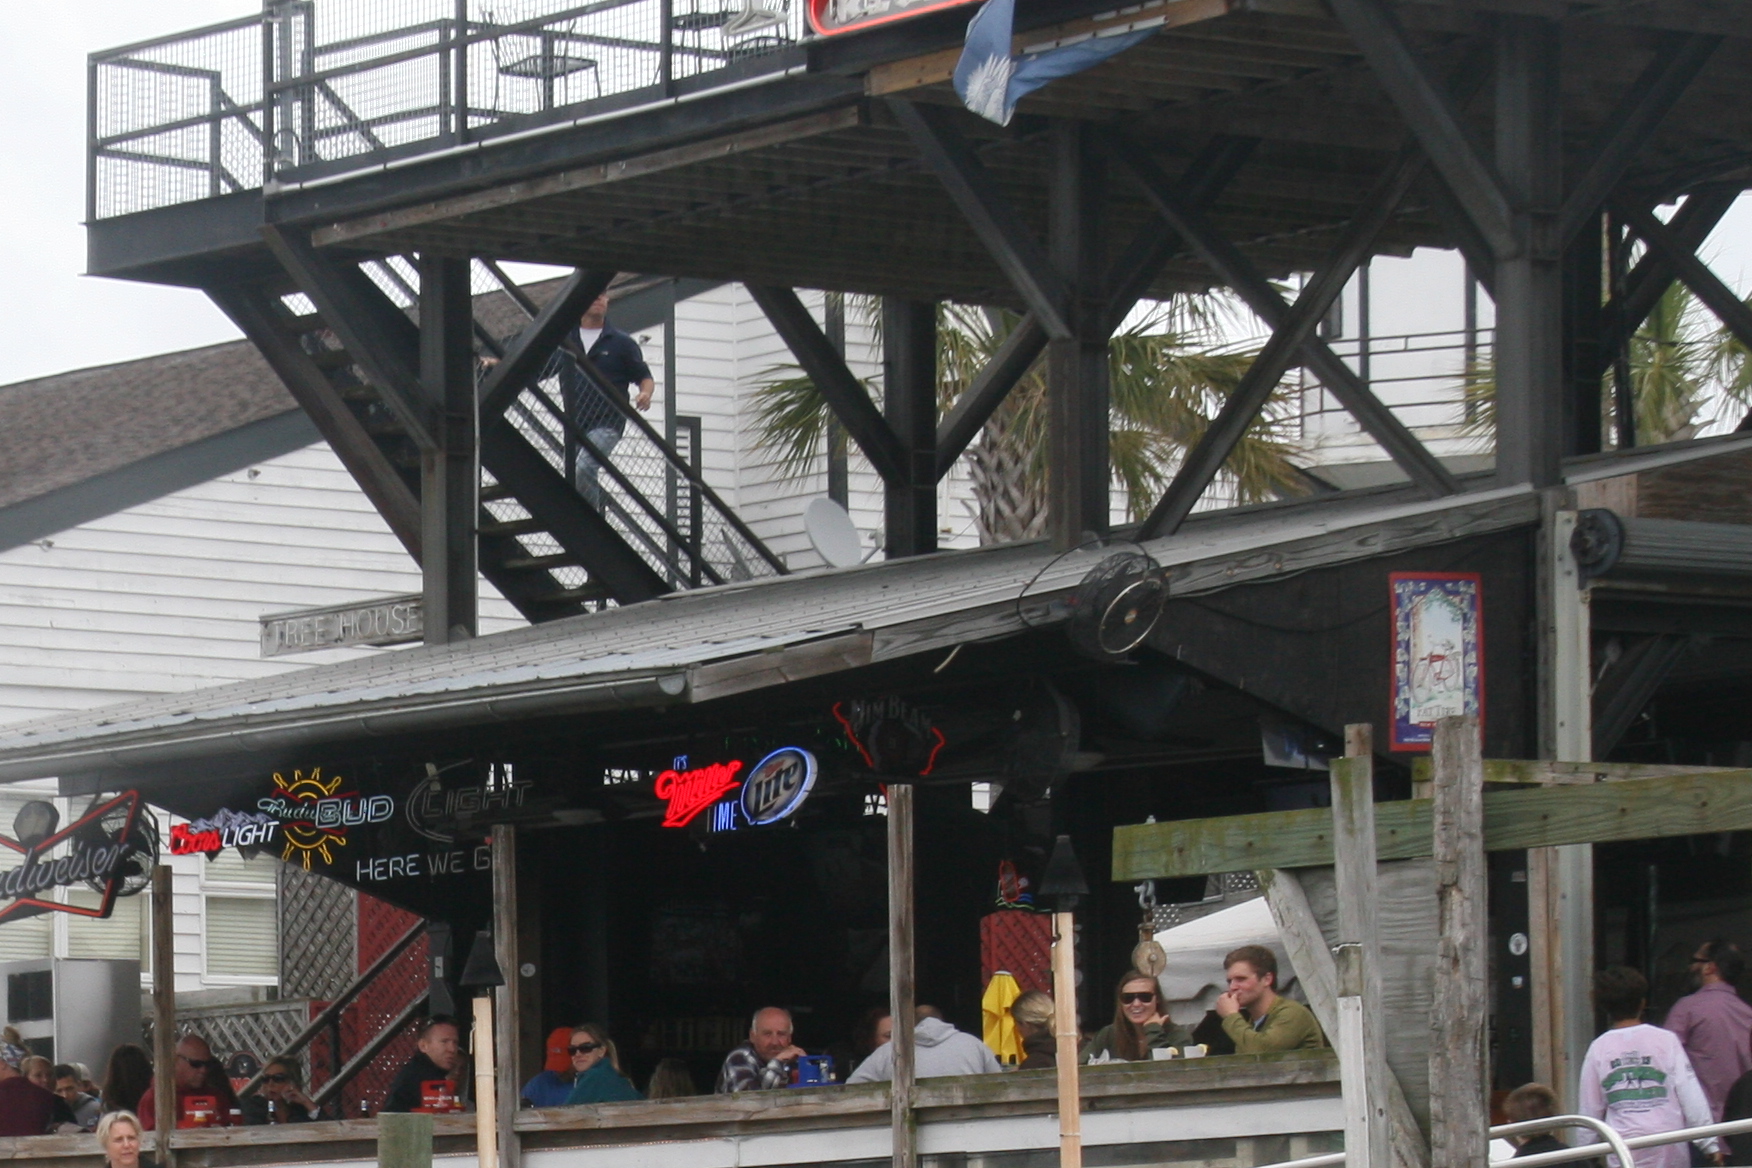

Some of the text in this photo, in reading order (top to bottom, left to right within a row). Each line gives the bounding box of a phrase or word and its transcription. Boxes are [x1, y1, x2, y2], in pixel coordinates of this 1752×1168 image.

[270, 603, 421, 646] TREE HOUSE
[315, 795, 394, 828] BUD
[422, 780, 533, 818] LIGHT
[654, 760, 743, 822] Miller
[752, 762, 799, 817] Lite
[221, 820, 280, 848] LIGHT
[356, 846, 491, 881] HERE WE G
